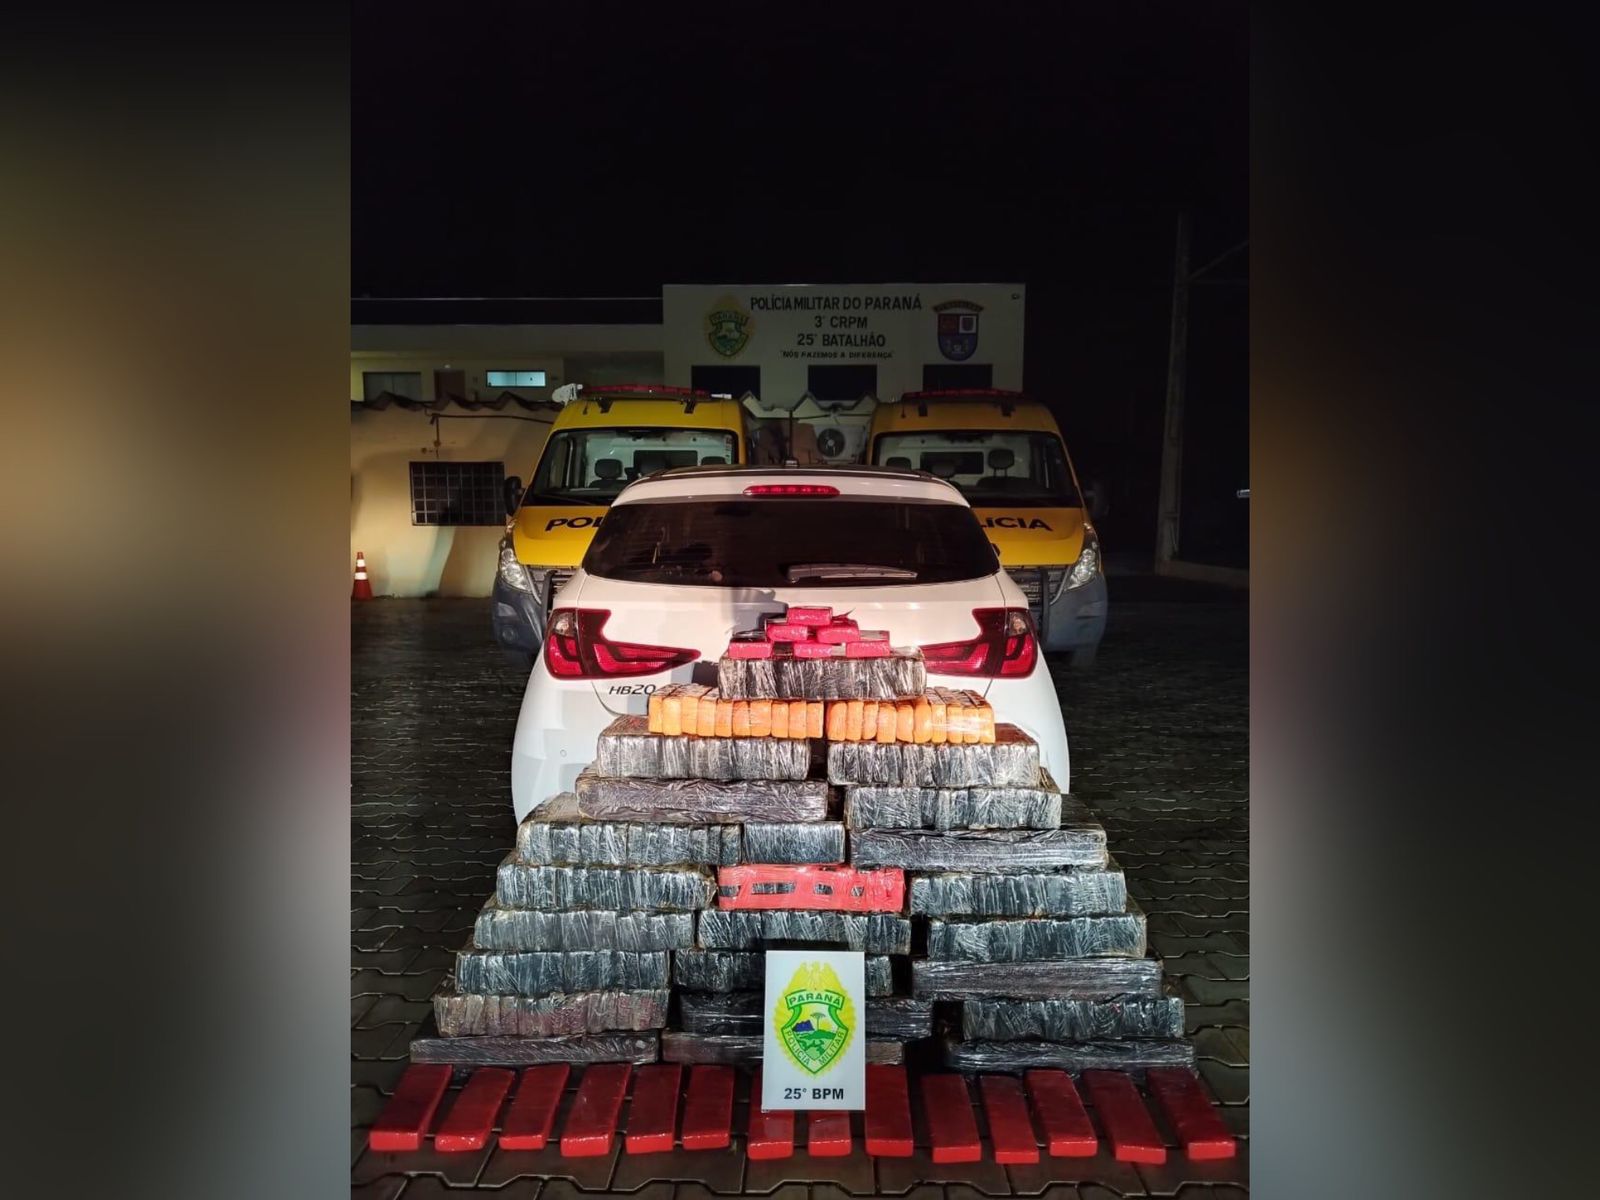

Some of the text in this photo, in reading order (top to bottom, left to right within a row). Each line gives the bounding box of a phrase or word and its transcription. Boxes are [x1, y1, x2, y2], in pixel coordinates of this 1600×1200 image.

[750, 294, 792, 310] POLÍCIA
[794, 296, 840, 310] MILITAR
[843, 296, 861, 310] DO
[865, 293, 922, 310] PARANÁ
[830, 316, 868, 329] CRPM
[822, 331, 886, 347] BATALHÃO
[801, 351, 838, 359] FAZEMOS
[840, 351, 846, 359] A
[608, 684, 656, 695] HB20
[789, 992, 841, 1006] PARANÁ
[818, 1031, 845, 1066] MILITAR
[812, 1088, 844, 1100] BPM
